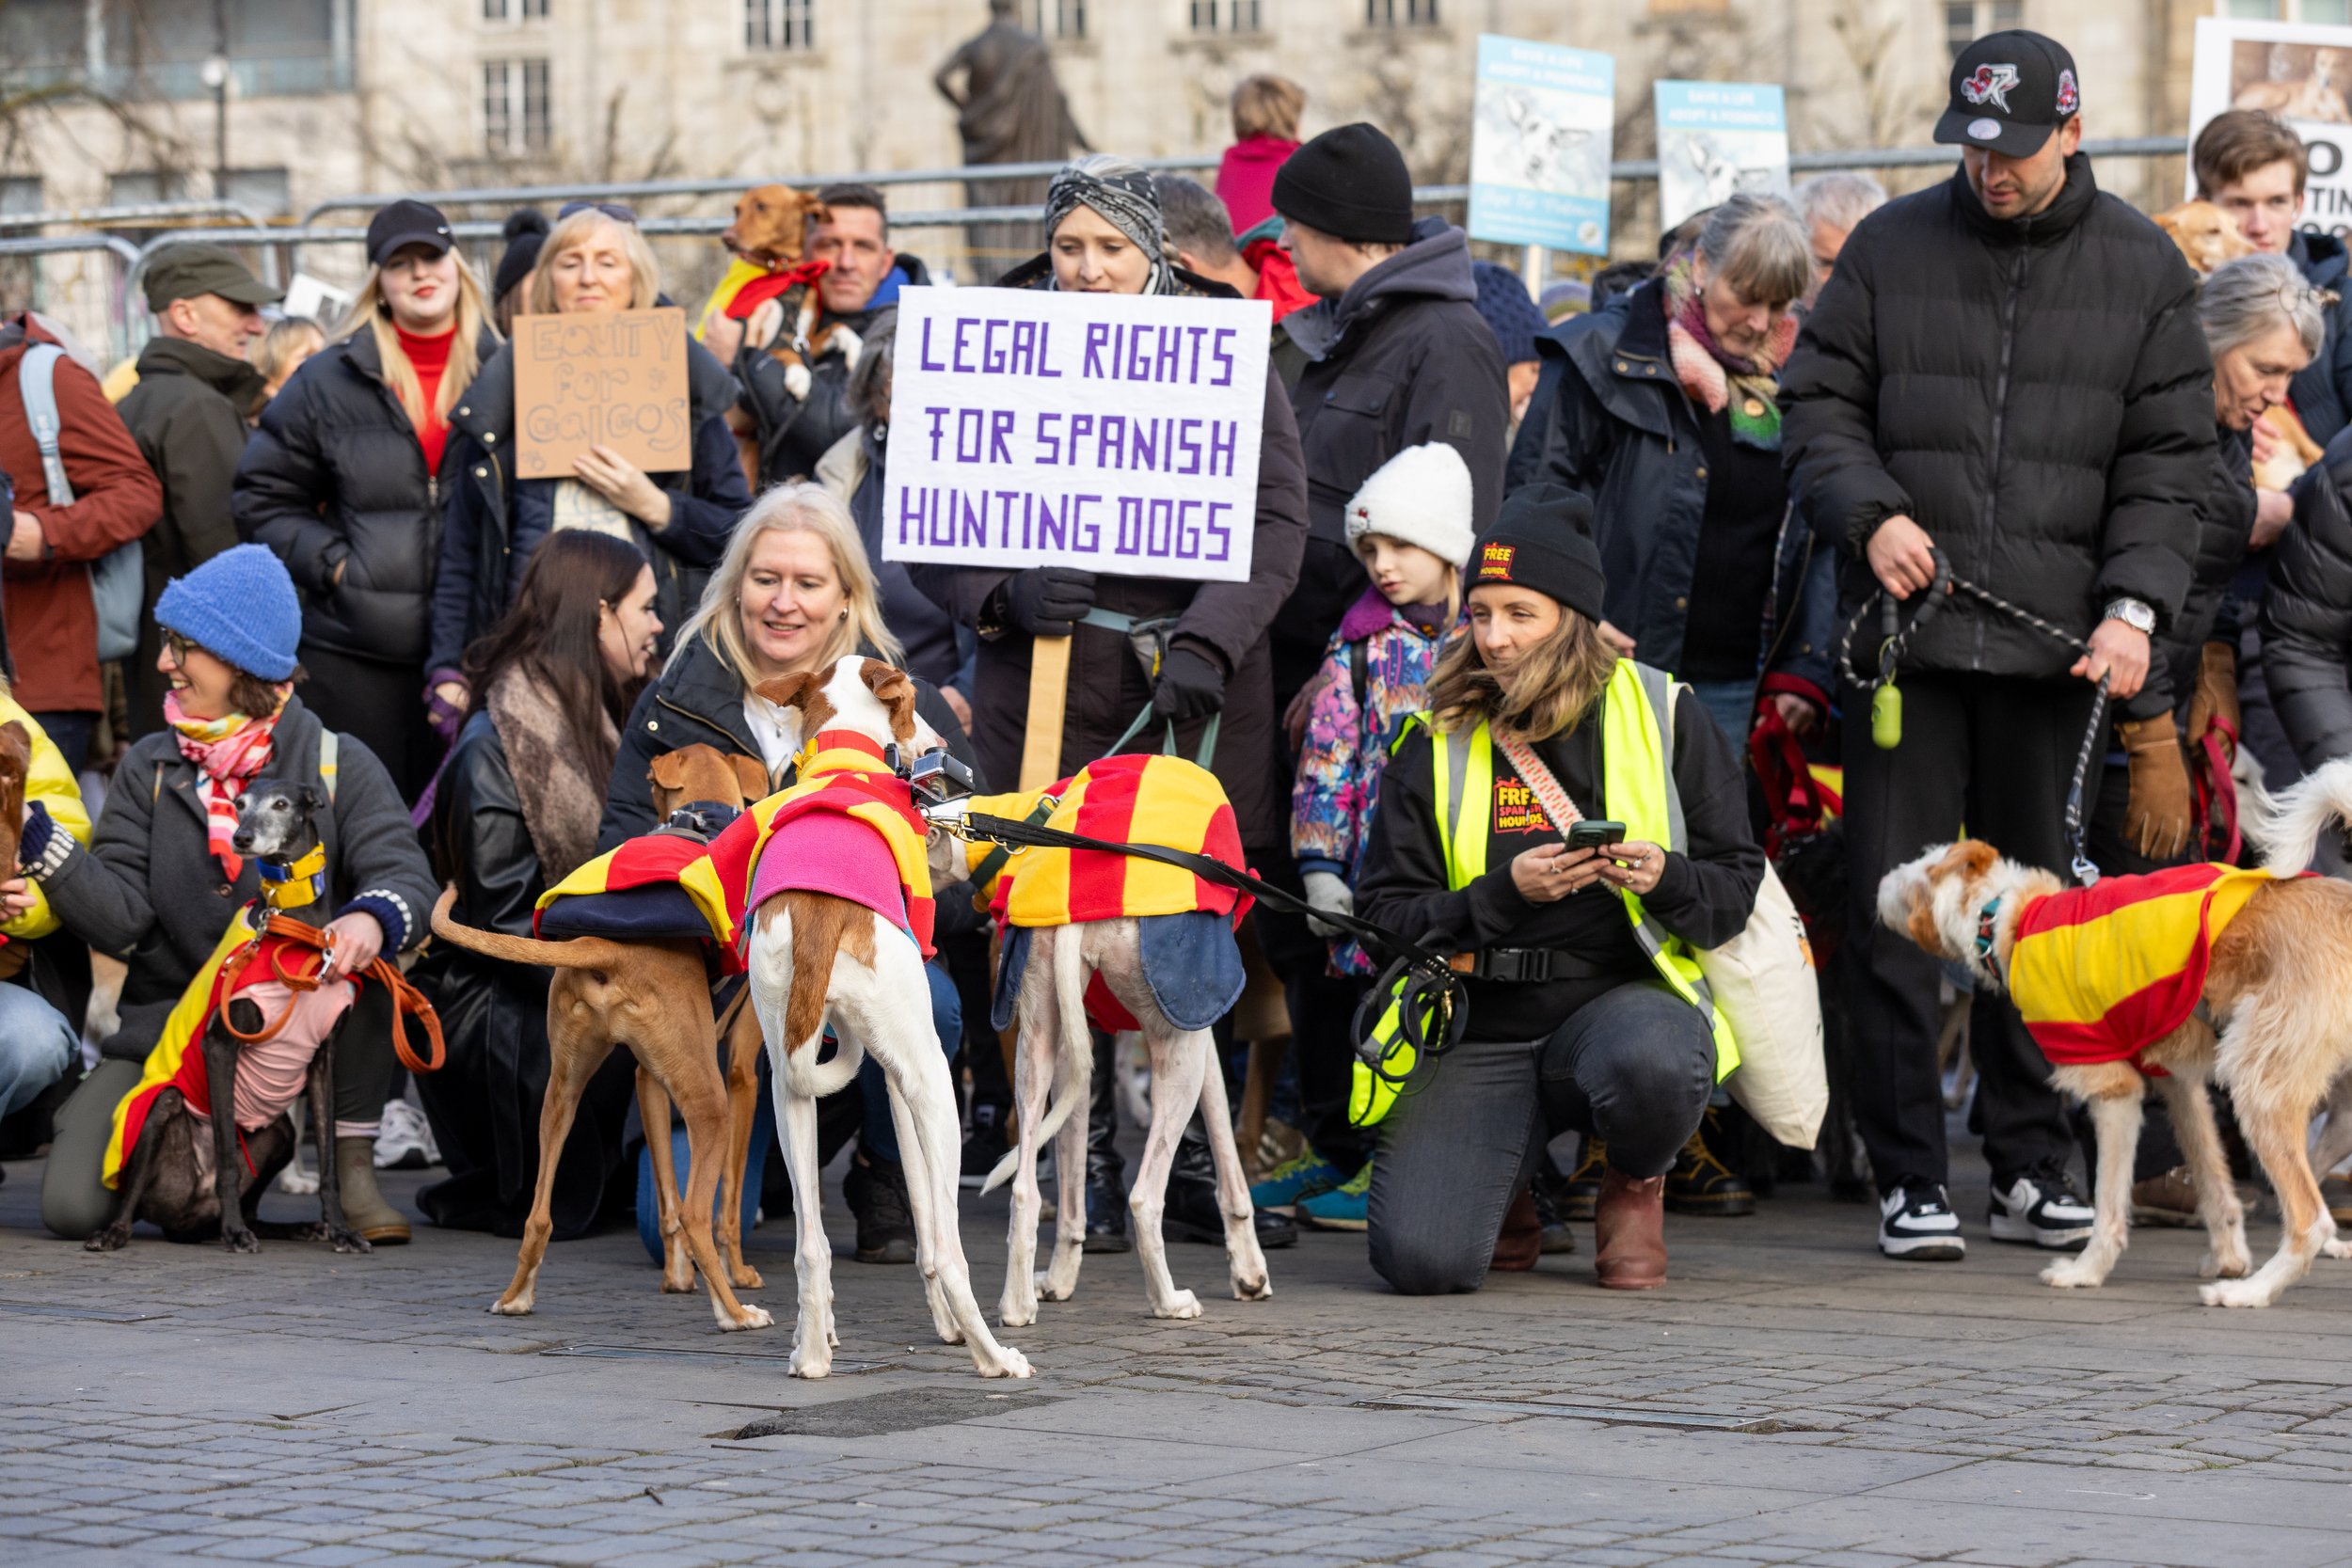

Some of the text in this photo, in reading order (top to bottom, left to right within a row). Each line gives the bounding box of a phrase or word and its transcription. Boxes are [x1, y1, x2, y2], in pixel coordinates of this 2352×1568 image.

[532, 312, 682, 362] EQUITY
[921, 317, 1237, 388] LEGAL RIGHTS
[925, 406, 1238, 478] FOR SPANISH
[899, 486, 1234, 562] HUNTING DOGS
[1484, 547, 1512, 562] FREE
[1499, 803, 1542, 816] SPANSH
